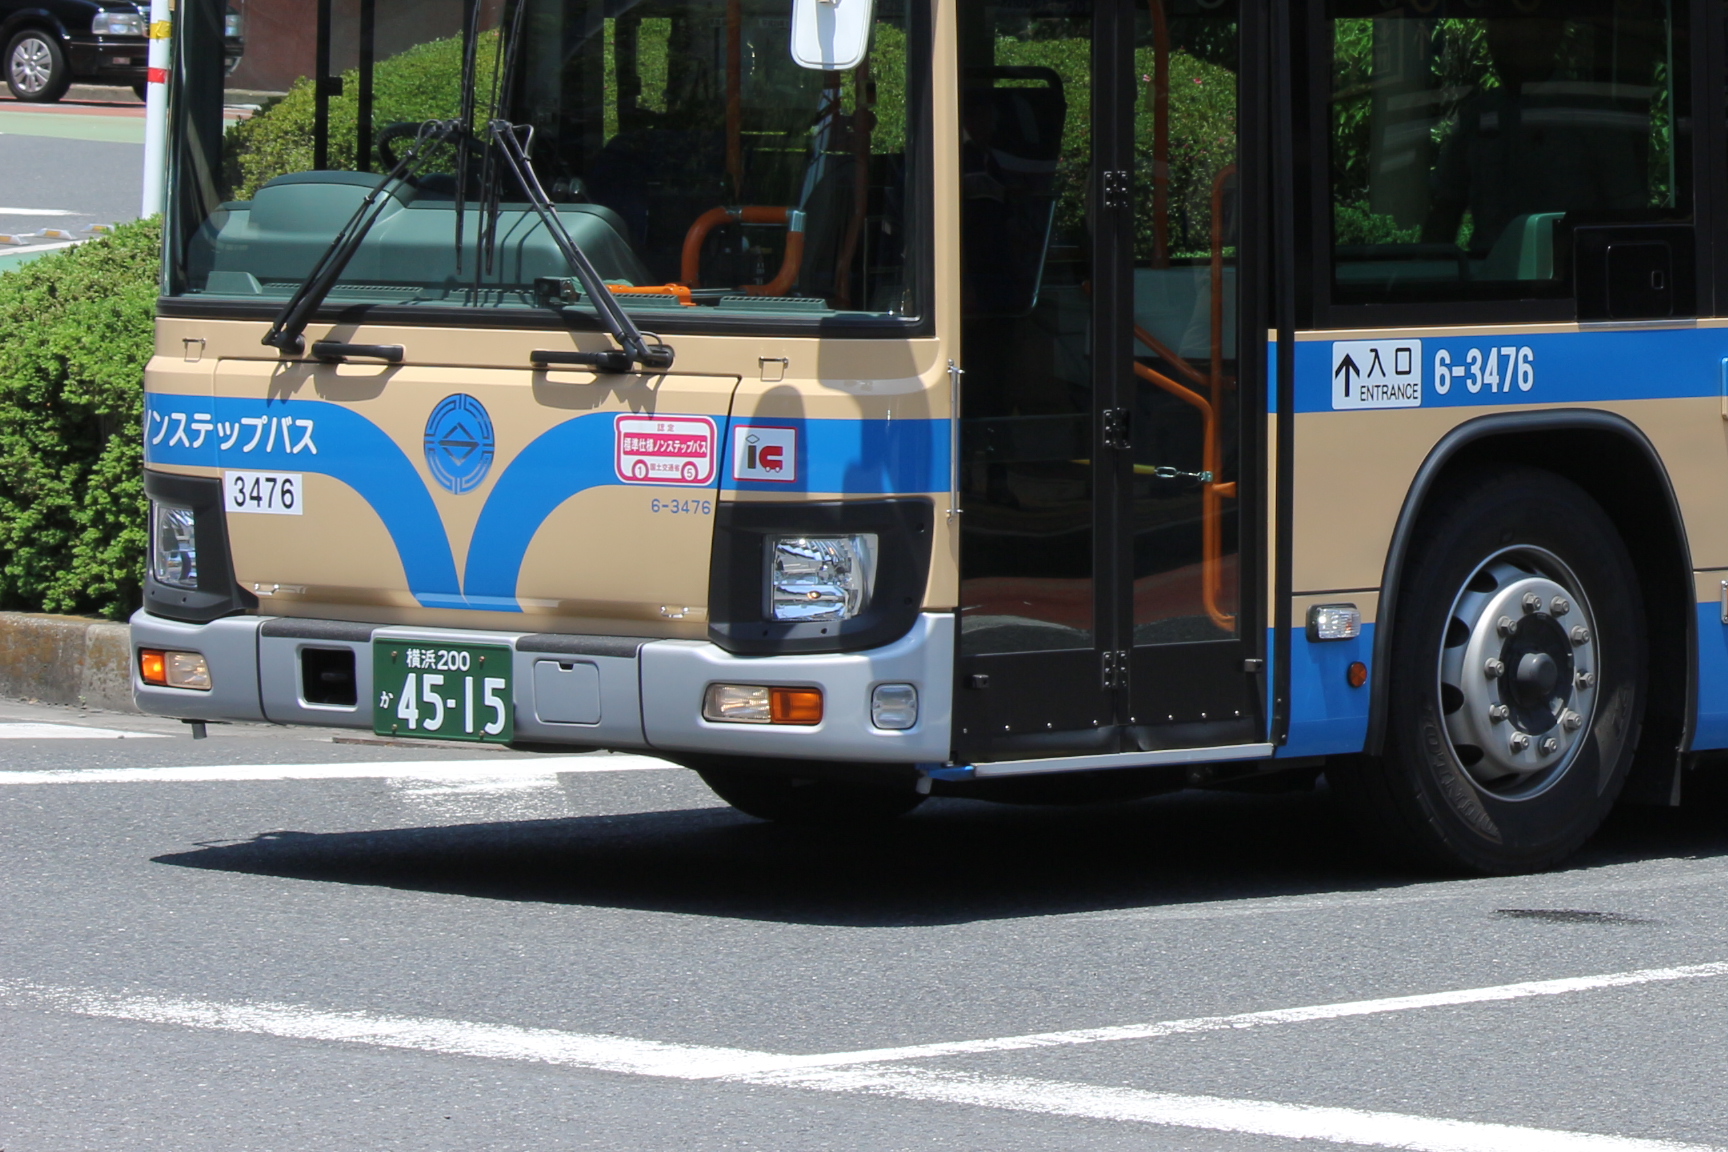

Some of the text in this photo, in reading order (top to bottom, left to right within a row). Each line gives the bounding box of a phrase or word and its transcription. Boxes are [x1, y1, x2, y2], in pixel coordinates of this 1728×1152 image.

[1367, 347, 1412, 378] 入口
[1434, 346, 1534, 395] 6-3476
[1360, 383, 1418, 402] ENTRANCE
[144, 409, 317, 455] ノンステップバス
[657, 423, 675, 432] 認定
[623, 437, 707, 454] 標準仕様ノンステップバス
[650, 463, 680, 473] 国土交通省
[233, 476, 295, 510] 3476
[651, 498, 711, 515] 6-3476
[406, 648, 470, 671] 横浜200
[380, 672, 506, 735] か 45-15
